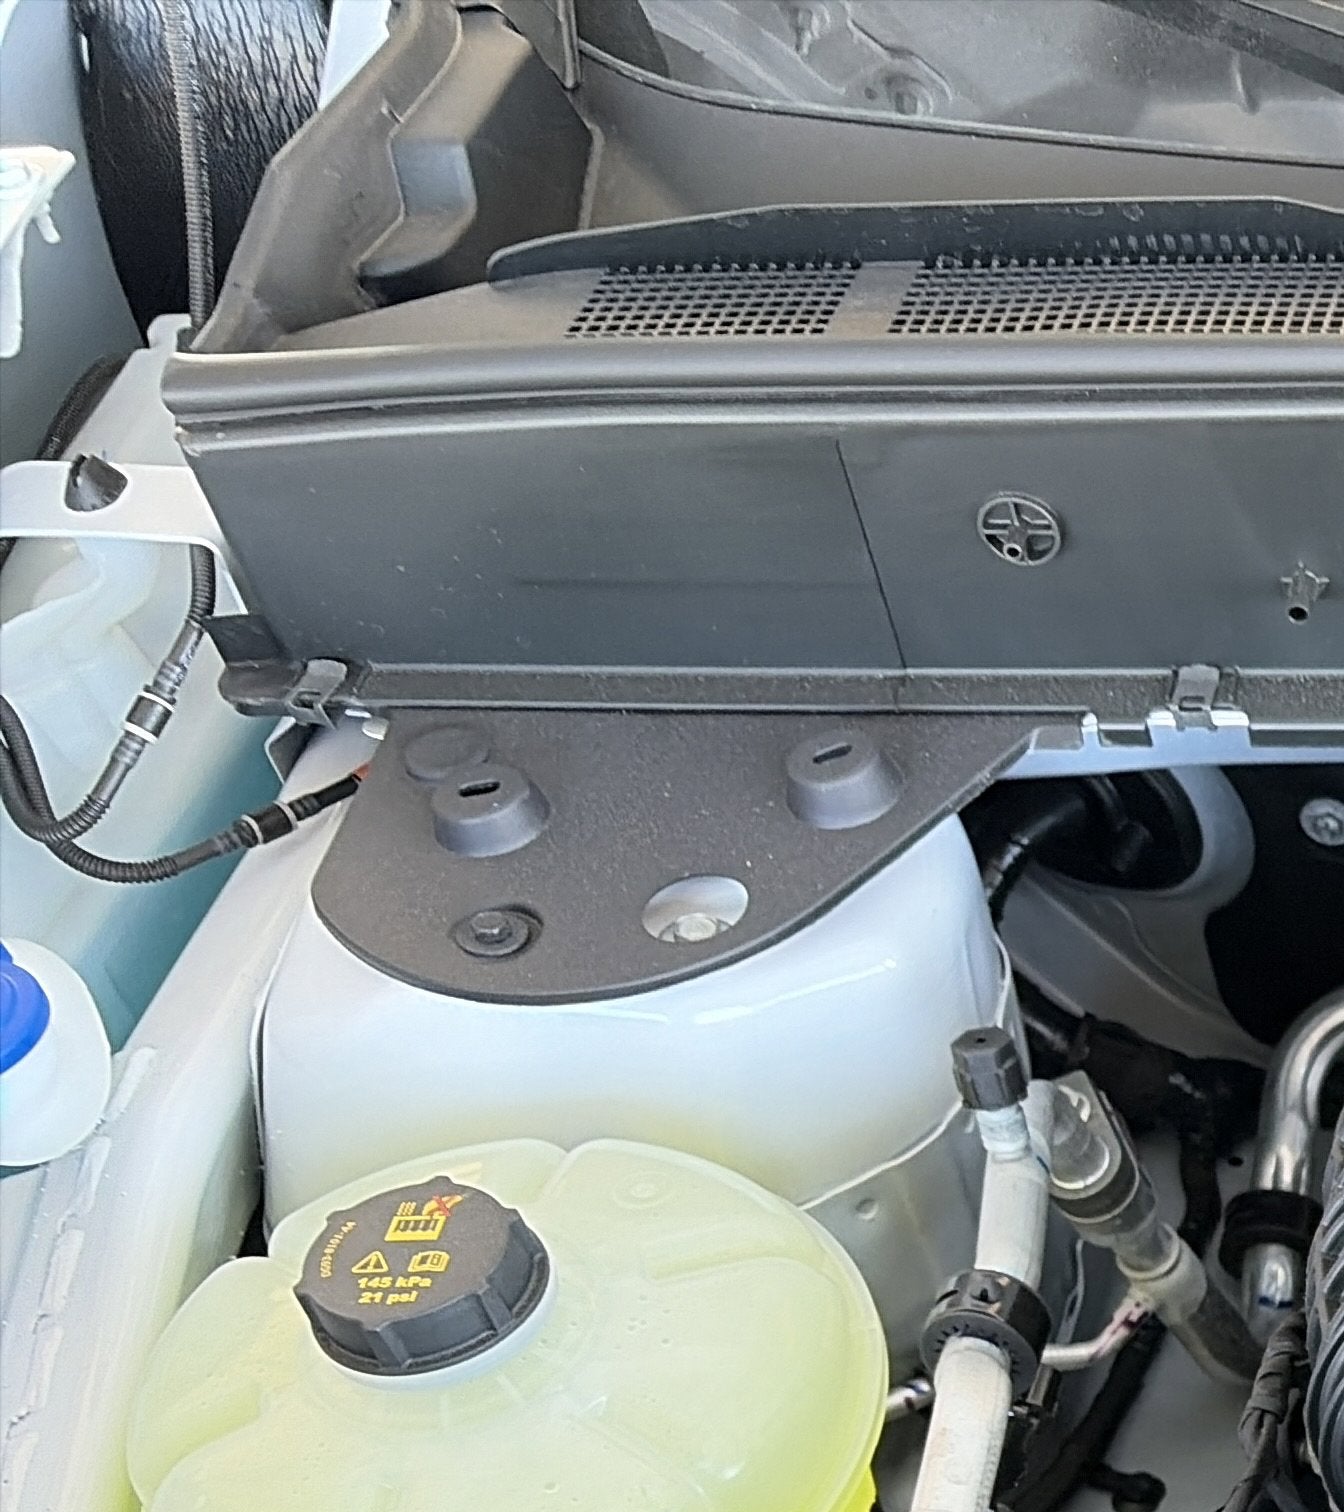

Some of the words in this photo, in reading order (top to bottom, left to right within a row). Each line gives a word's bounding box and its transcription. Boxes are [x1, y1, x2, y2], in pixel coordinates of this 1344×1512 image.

[358, 1277, 392, 1289] 145
[395, 1276, 432, 1289] kPa
[358, 1292, 383, 1304] 21
[386, 1290, 418, 1305] psi
